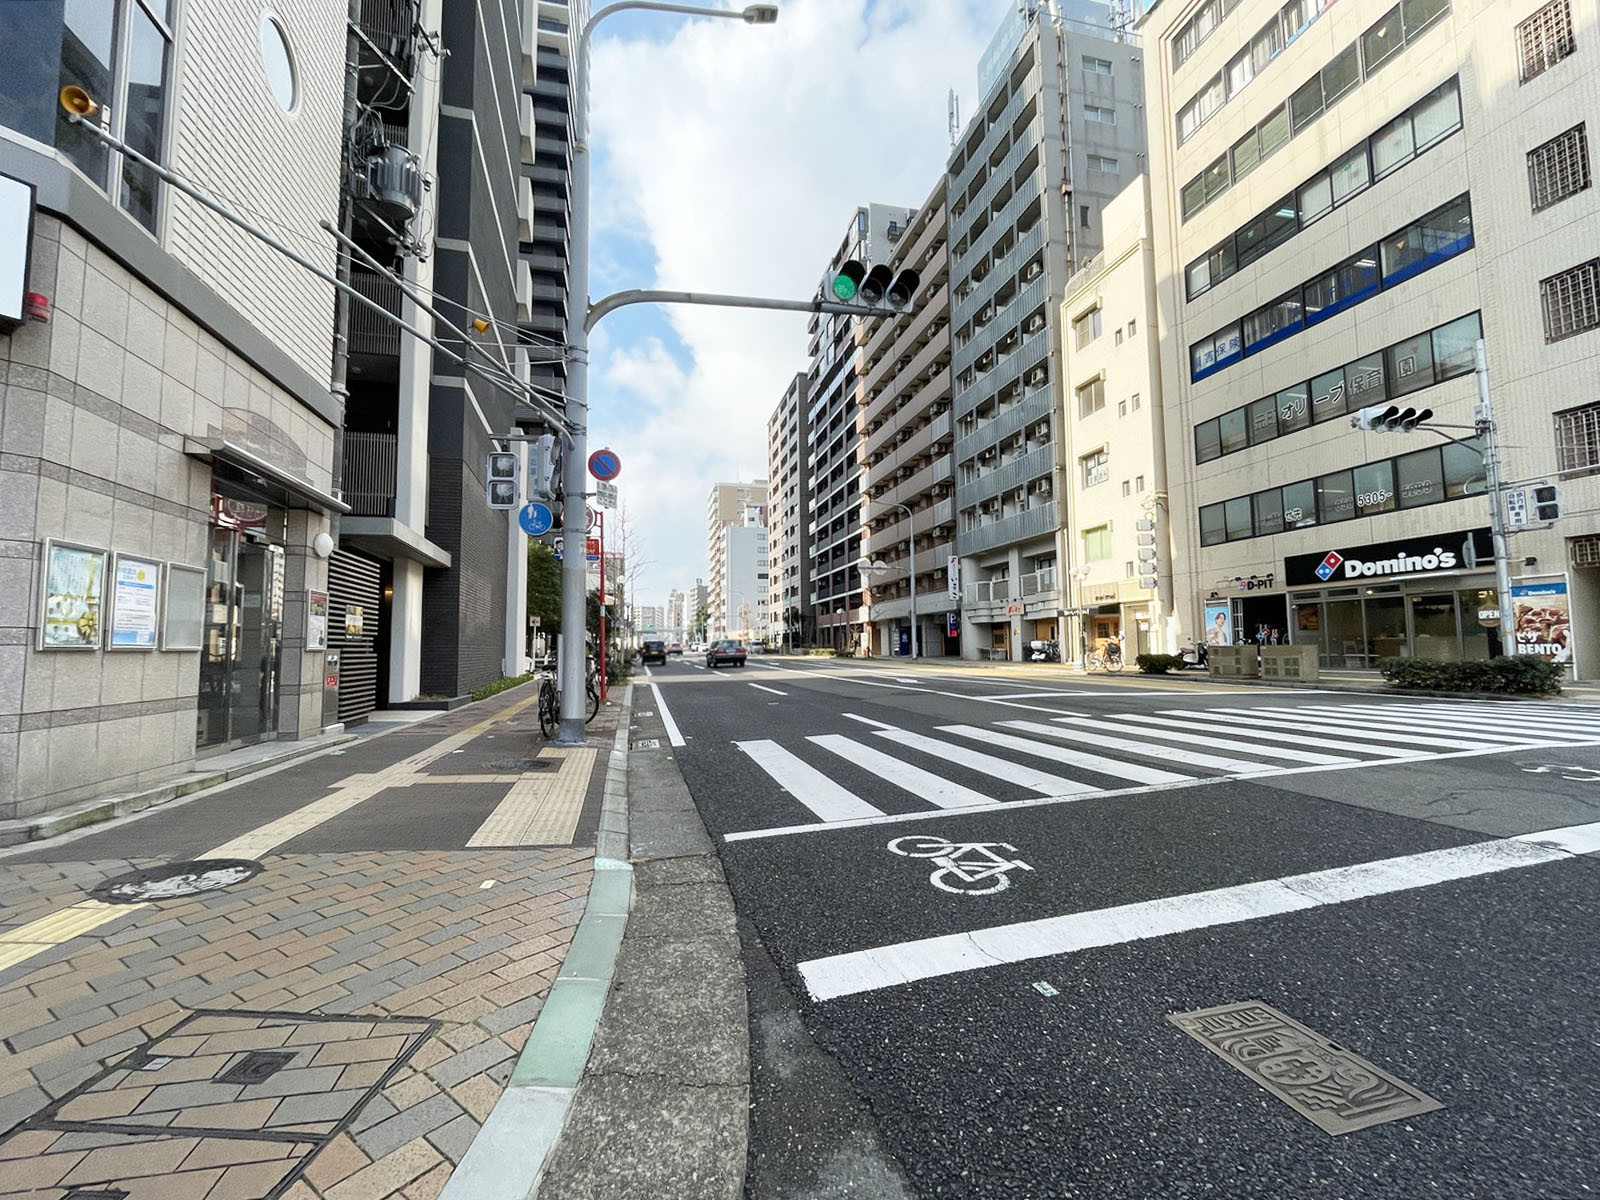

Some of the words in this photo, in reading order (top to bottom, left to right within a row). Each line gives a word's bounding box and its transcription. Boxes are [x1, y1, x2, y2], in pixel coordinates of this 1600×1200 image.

[1344, 547, 1456, 578] Domino's
[1247, 579, 1274, 590] D-PIT
[1478, 610, 1500, 619] OPEN
[1517, 643, 1562, 655] BENTO
